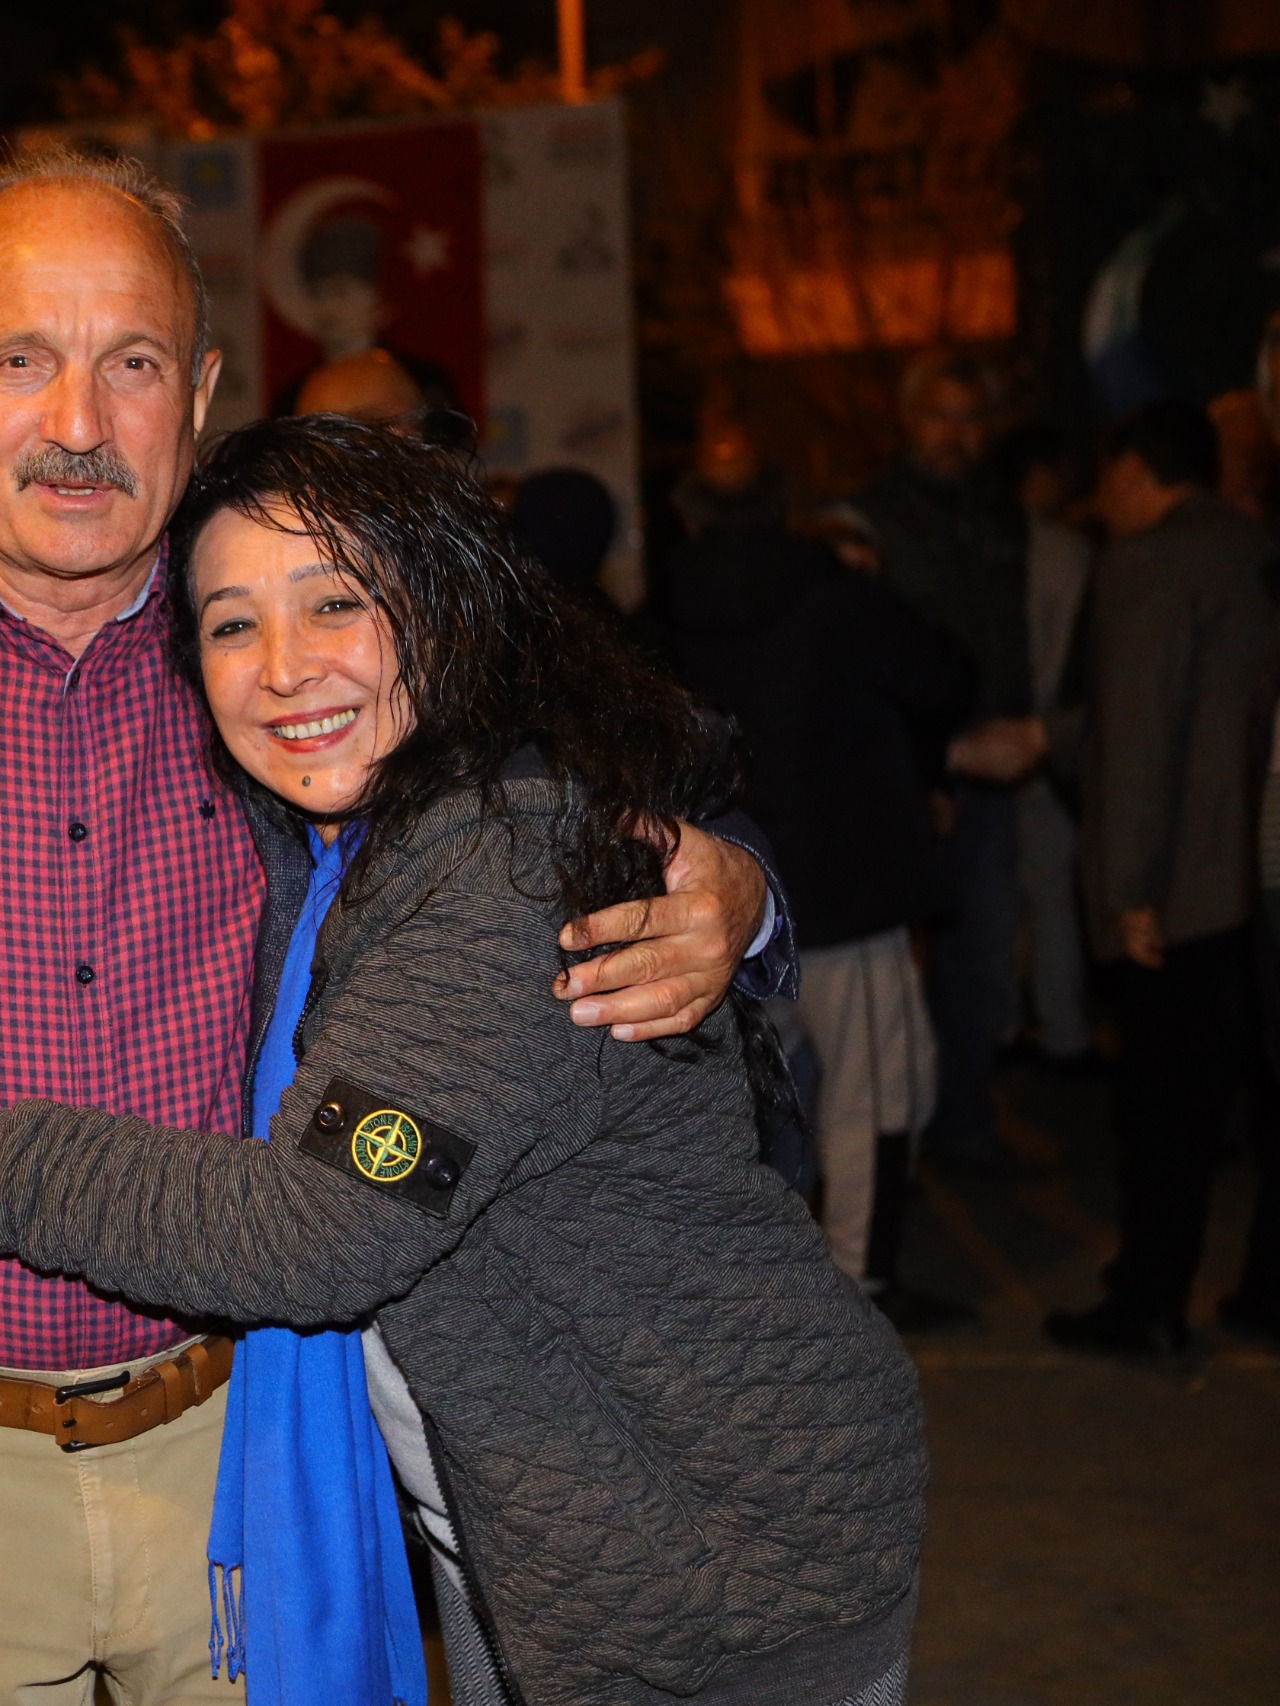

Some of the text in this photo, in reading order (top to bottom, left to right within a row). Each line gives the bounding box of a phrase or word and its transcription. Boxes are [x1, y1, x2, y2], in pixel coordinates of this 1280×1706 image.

[364, 1115, 394, 1133] STONE
[401, 1122, 417, 1153] ISLAND
[356, 1140, 372, 1170] ISLAND
[380, 1160, 410, 1177] STONE
